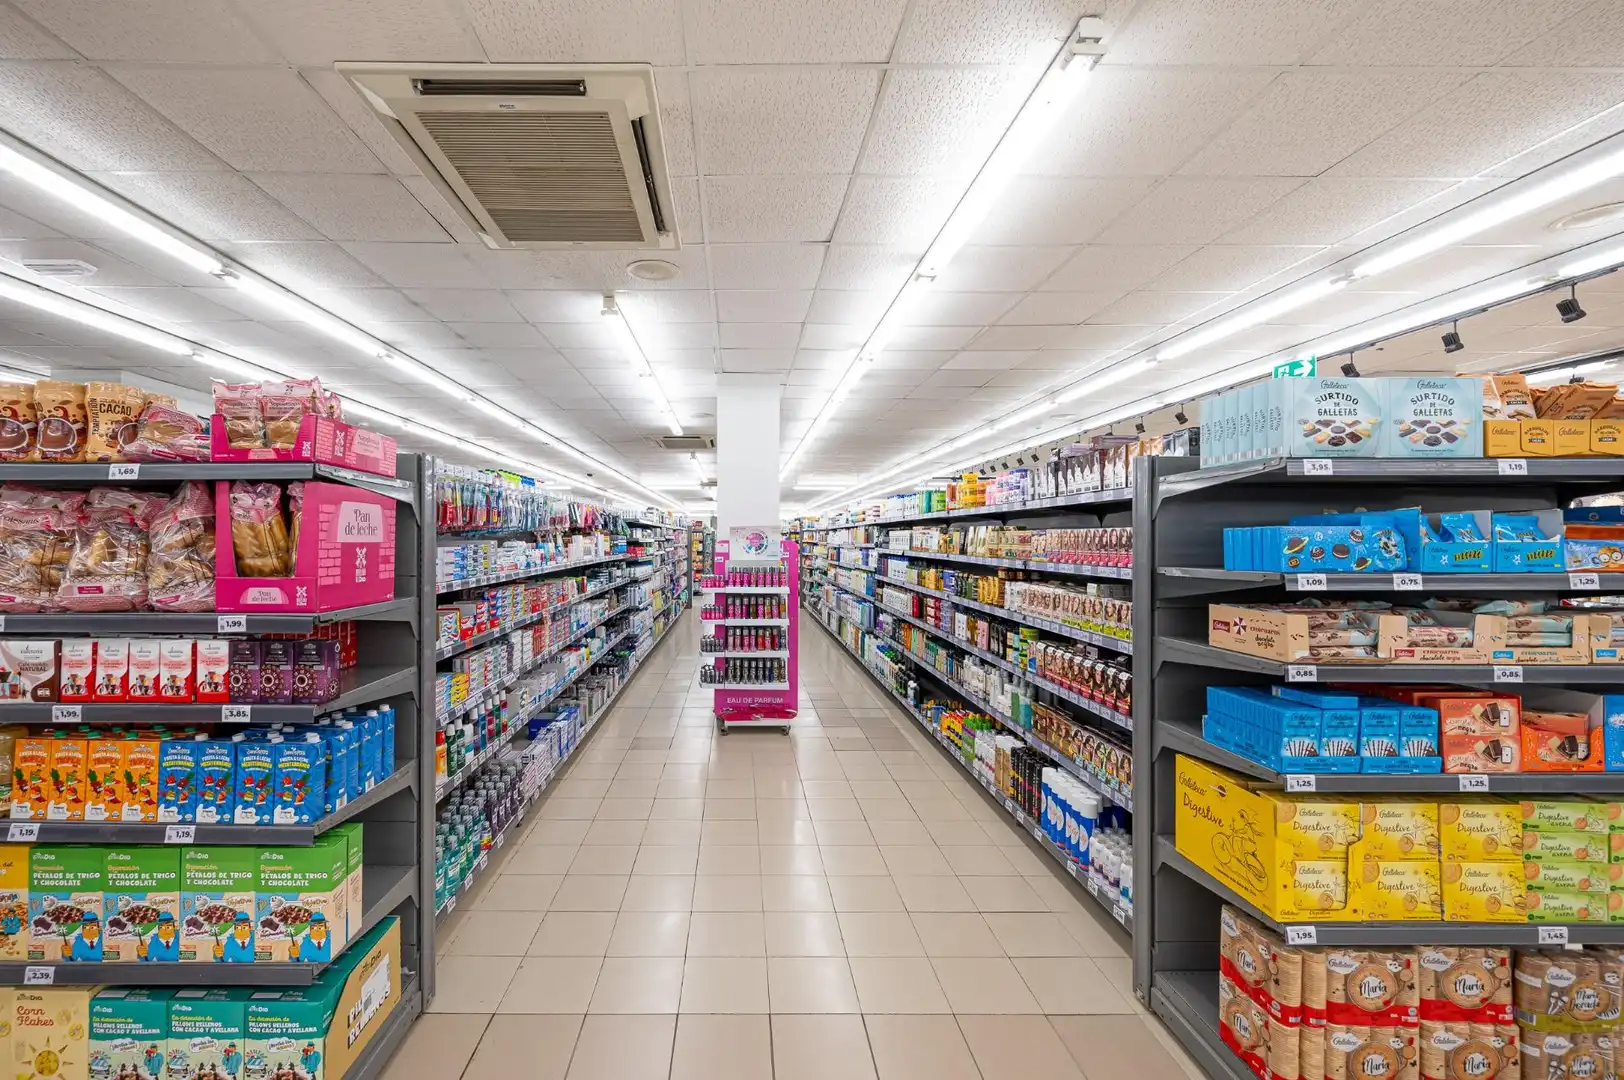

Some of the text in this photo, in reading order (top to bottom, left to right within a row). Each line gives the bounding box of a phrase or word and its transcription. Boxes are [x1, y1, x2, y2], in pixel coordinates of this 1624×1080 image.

[1320, 380, 1350, 390] Galleteca
[1416, 380, 1446, 390] Galleteca
[1314, 392, 1360, 406] SURTIDO
[1410, 392, 1455, 406] SURTIDO
[100, 402, 132, 416] CACAO
[1318, 408, 1358, 416] GALLETAS
[1413, 408, 1453, 416] GALLETAS
[90, 398, 100, 436] TEMPTATION
[354, 508, 370, 523] Pan
[344, 522, 378, 536] de leche
[1454, 549, 1481, 561] mini
[1527, 549, 1554, 561] mini
[1457, 726, 1476, 735] negro
[1459, 762, 1478, 771] negro
[1184, 792, 1224, 828] Digestive
[1538, 812, 1569, 821] Digestive
[1292, 820, 1332, 832] Digestive
[1374, 822, 1410, 836] Digestive
[1457, 822, 1494, 836] Digestive
[1541, 843, 1571, 852] Digestive
[186, 870, 216, 878] PÉTALOS
[261, 871, 291, 879] PÉTALOS
[1544, 874, 1575, 883] Digestive
[1293, 880, 1331, 891] Digestive
[1378, 881, 1414, 893] Digestive
[1460, 882, 1497, 895] Digestive
[1544, 904, 1574, 913] Digestive
[1238, 950, 1256, 971] María
[1360, 981, 1387, 996] María
[1454, 978, 1484, 993] María
[17, 1006, 45, 1016] Corn
[17, 1016, 54, 1026] Flakes
[1363, 1057, 1389, 1072] María
[1464, 1057, 1490, 1072] María
